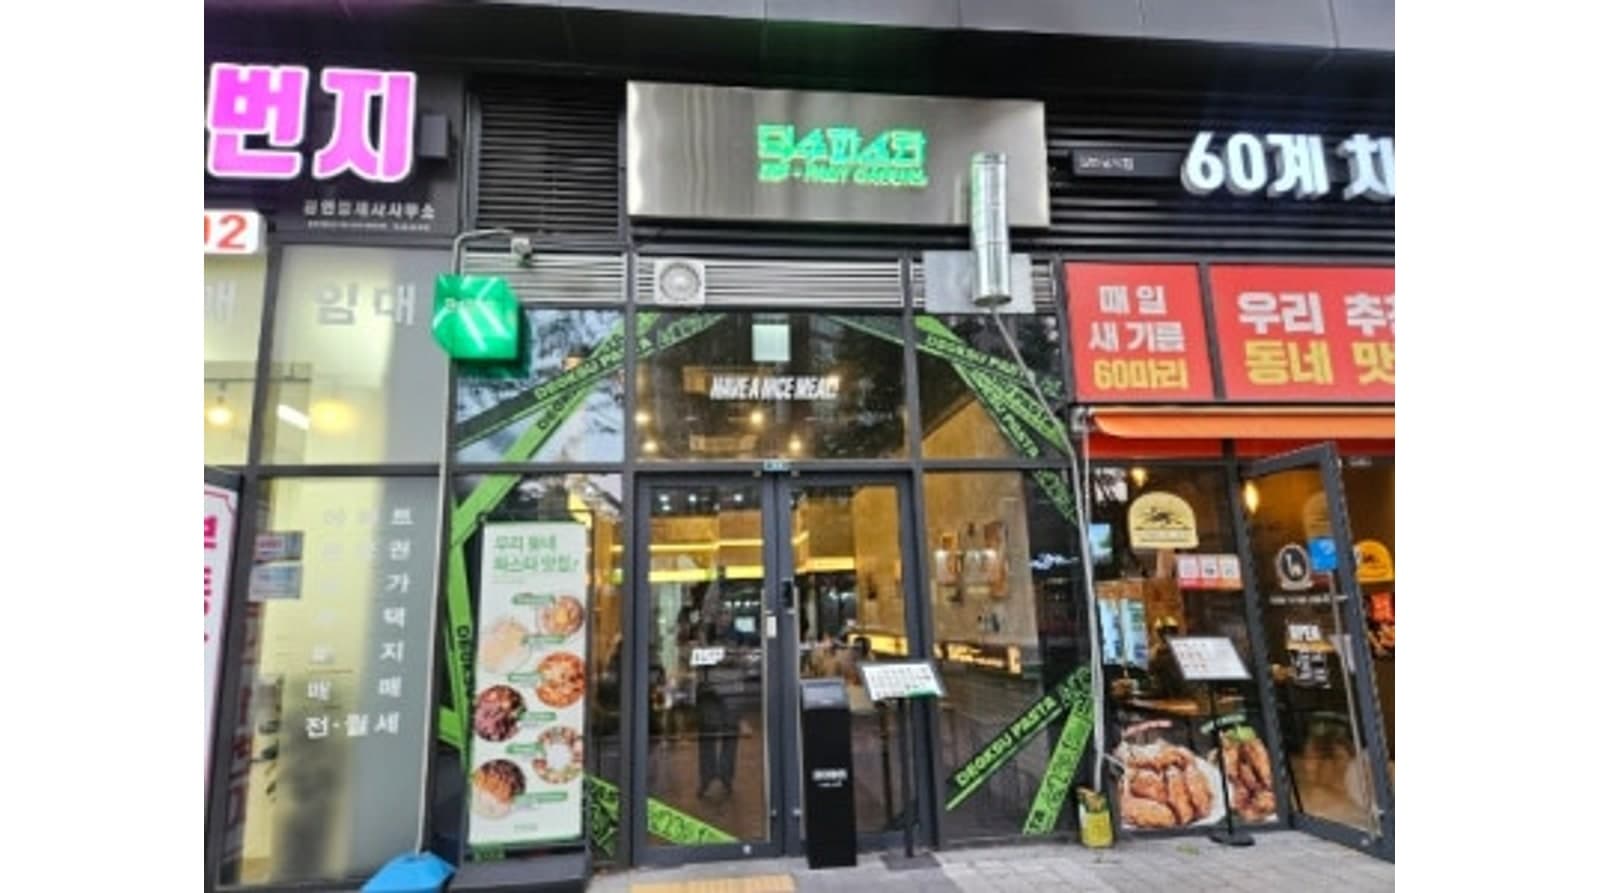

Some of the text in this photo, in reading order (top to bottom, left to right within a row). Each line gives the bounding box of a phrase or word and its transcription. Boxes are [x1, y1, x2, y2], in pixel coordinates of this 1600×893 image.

[206, 62, 417, 183] 번지
[1184, 131, 1330, 195] 60계
[1236, 291, 1326, 336] 우리
[1124, 321, 1186, 352] 기름
[1093, 358, 1189, 390] 60마리
[1244, 340, 1334, 385] 동네
[710, 375, 750, 401] HAVE
[761, 376, 795, 401] NICE
[954, 732, 1013, 788] DEOKSU
[1010, 695, 1057, 737] PASTA
